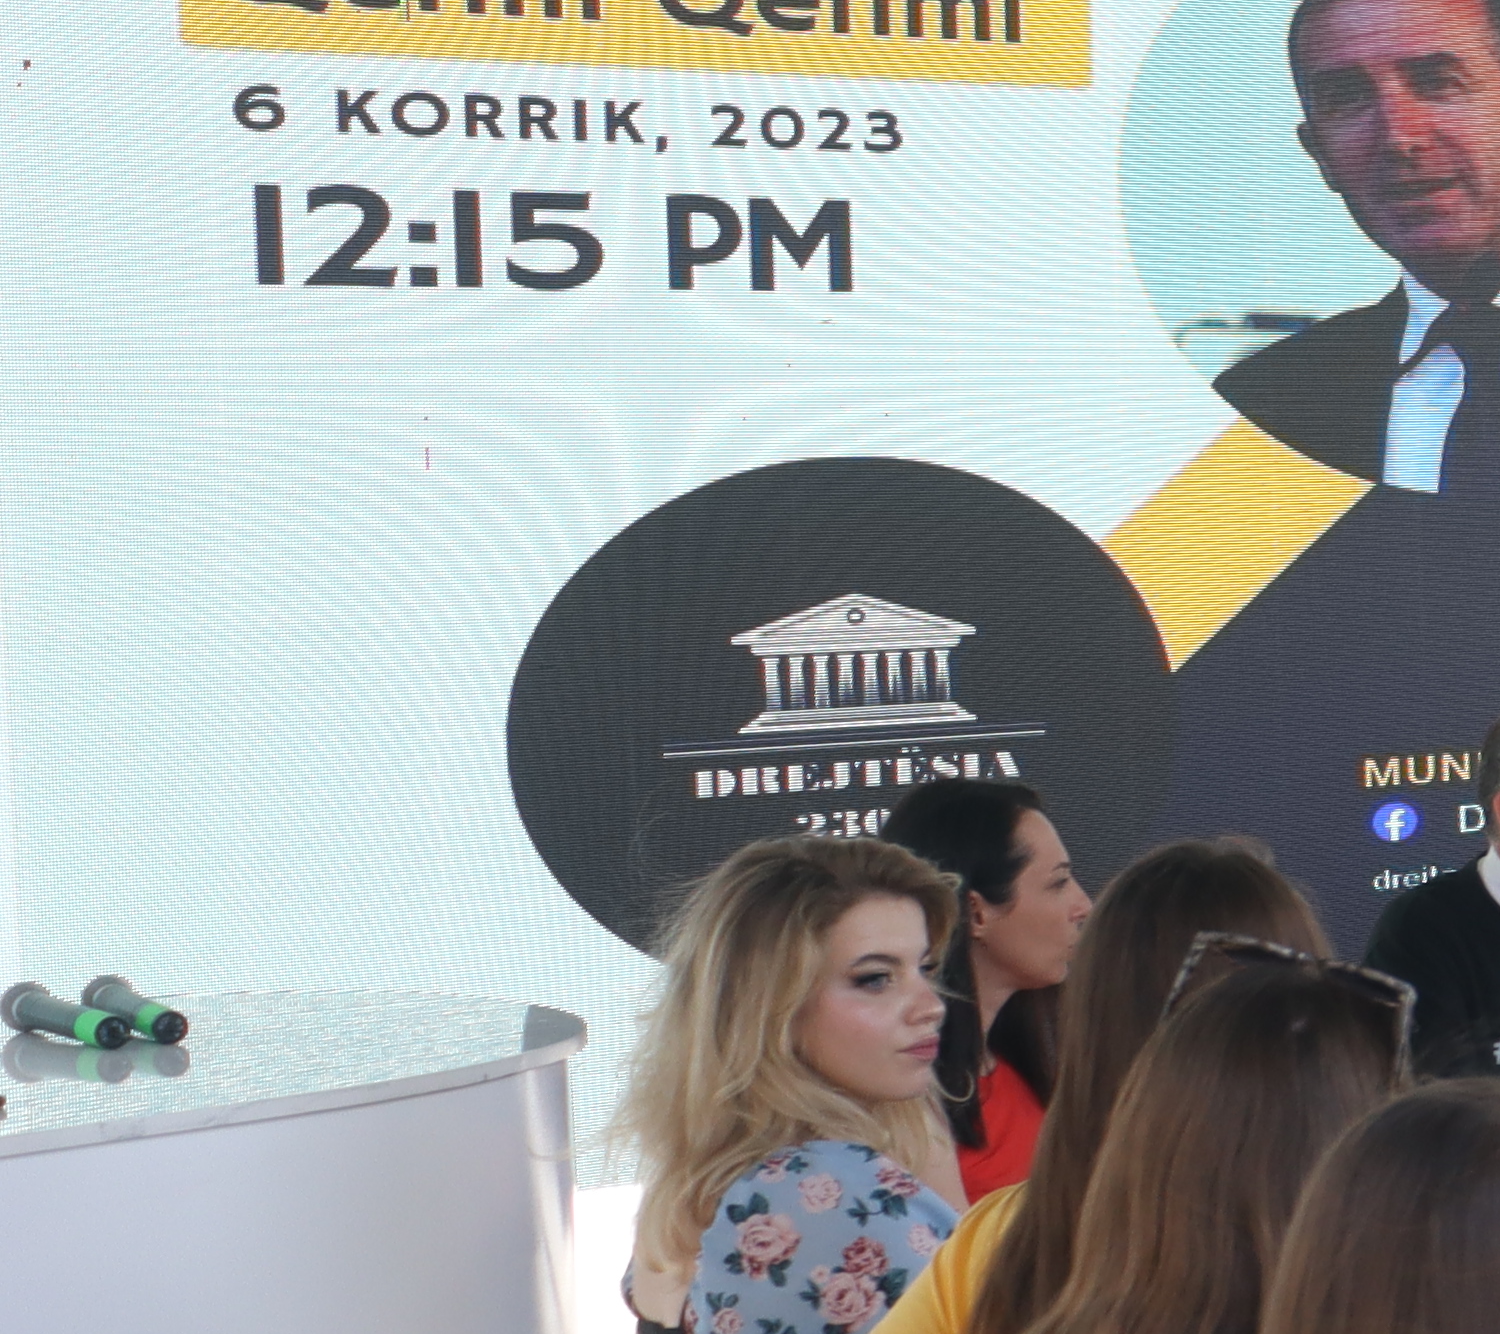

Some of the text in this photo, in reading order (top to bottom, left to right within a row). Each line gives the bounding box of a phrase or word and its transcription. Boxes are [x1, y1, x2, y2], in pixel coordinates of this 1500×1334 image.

[231, 85, 903, 153] 6 KORRIK, 2023
[253, 184, 854, 293] 12:15 PM
[694, 746, 1021, 798] DREJTËSIA
